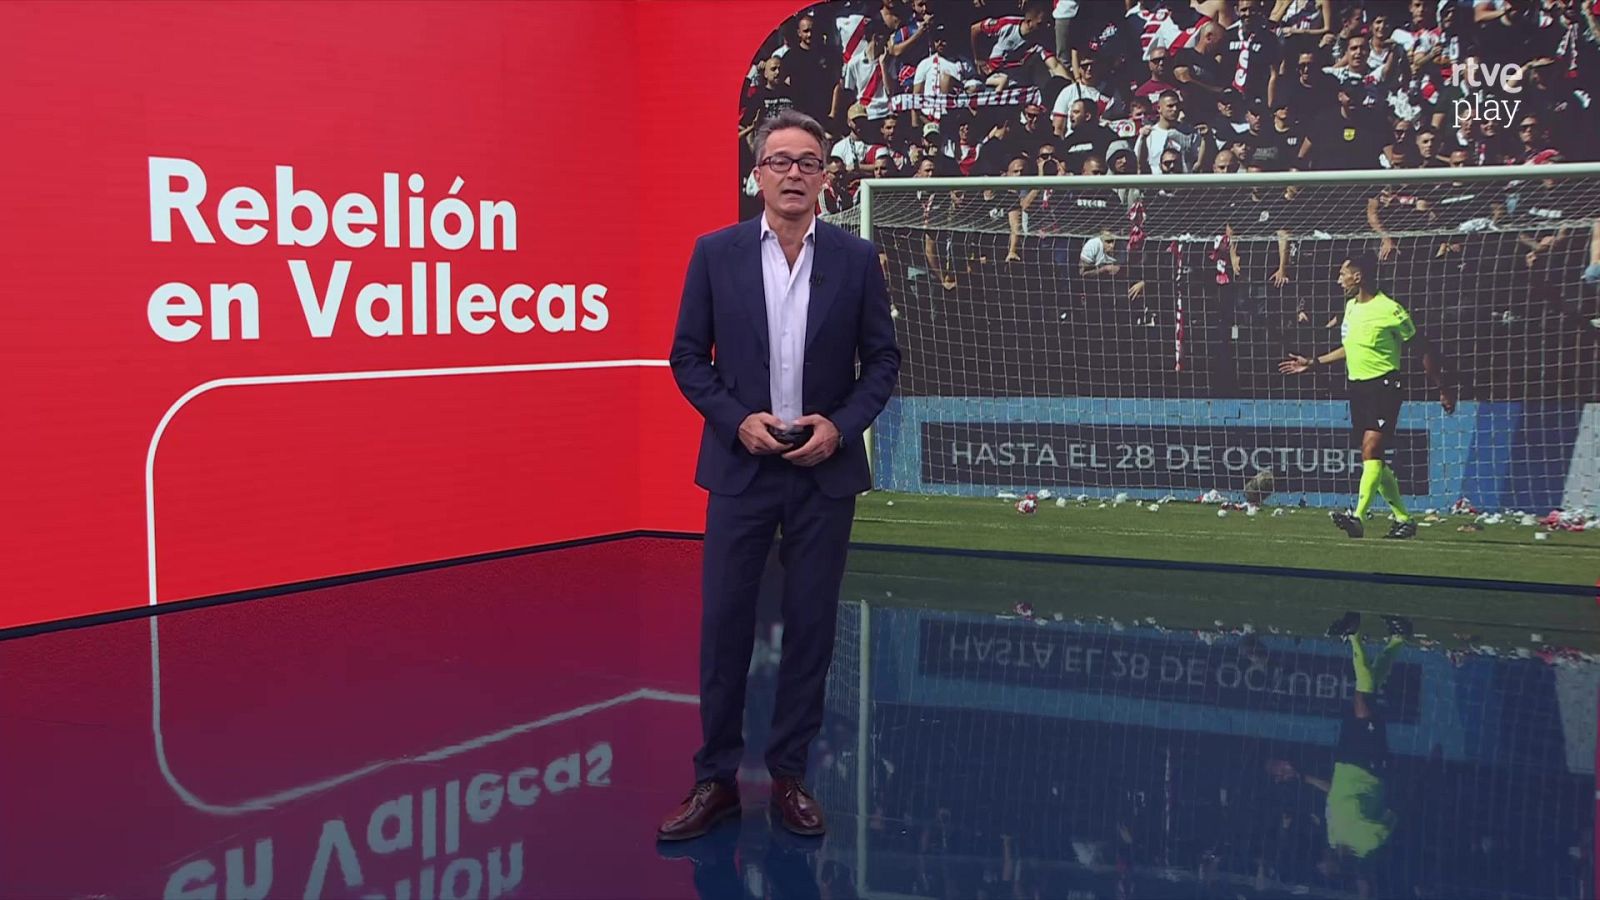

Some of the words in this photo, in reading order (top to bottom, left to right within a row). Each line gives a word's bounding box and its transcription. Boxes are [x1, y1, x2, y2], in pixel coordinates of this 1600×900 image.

[148, 156, 518, 251] Rebelión
[147, 282, 260, 342] en
[287, 259, 610, 338] Vallecas
[951, 442, 1060, 467] HASTA
[1068, 443, 1107, 468] EL
[1115, 444, 1155, 469] 28
[1166, 445, 1211, 471] DE
